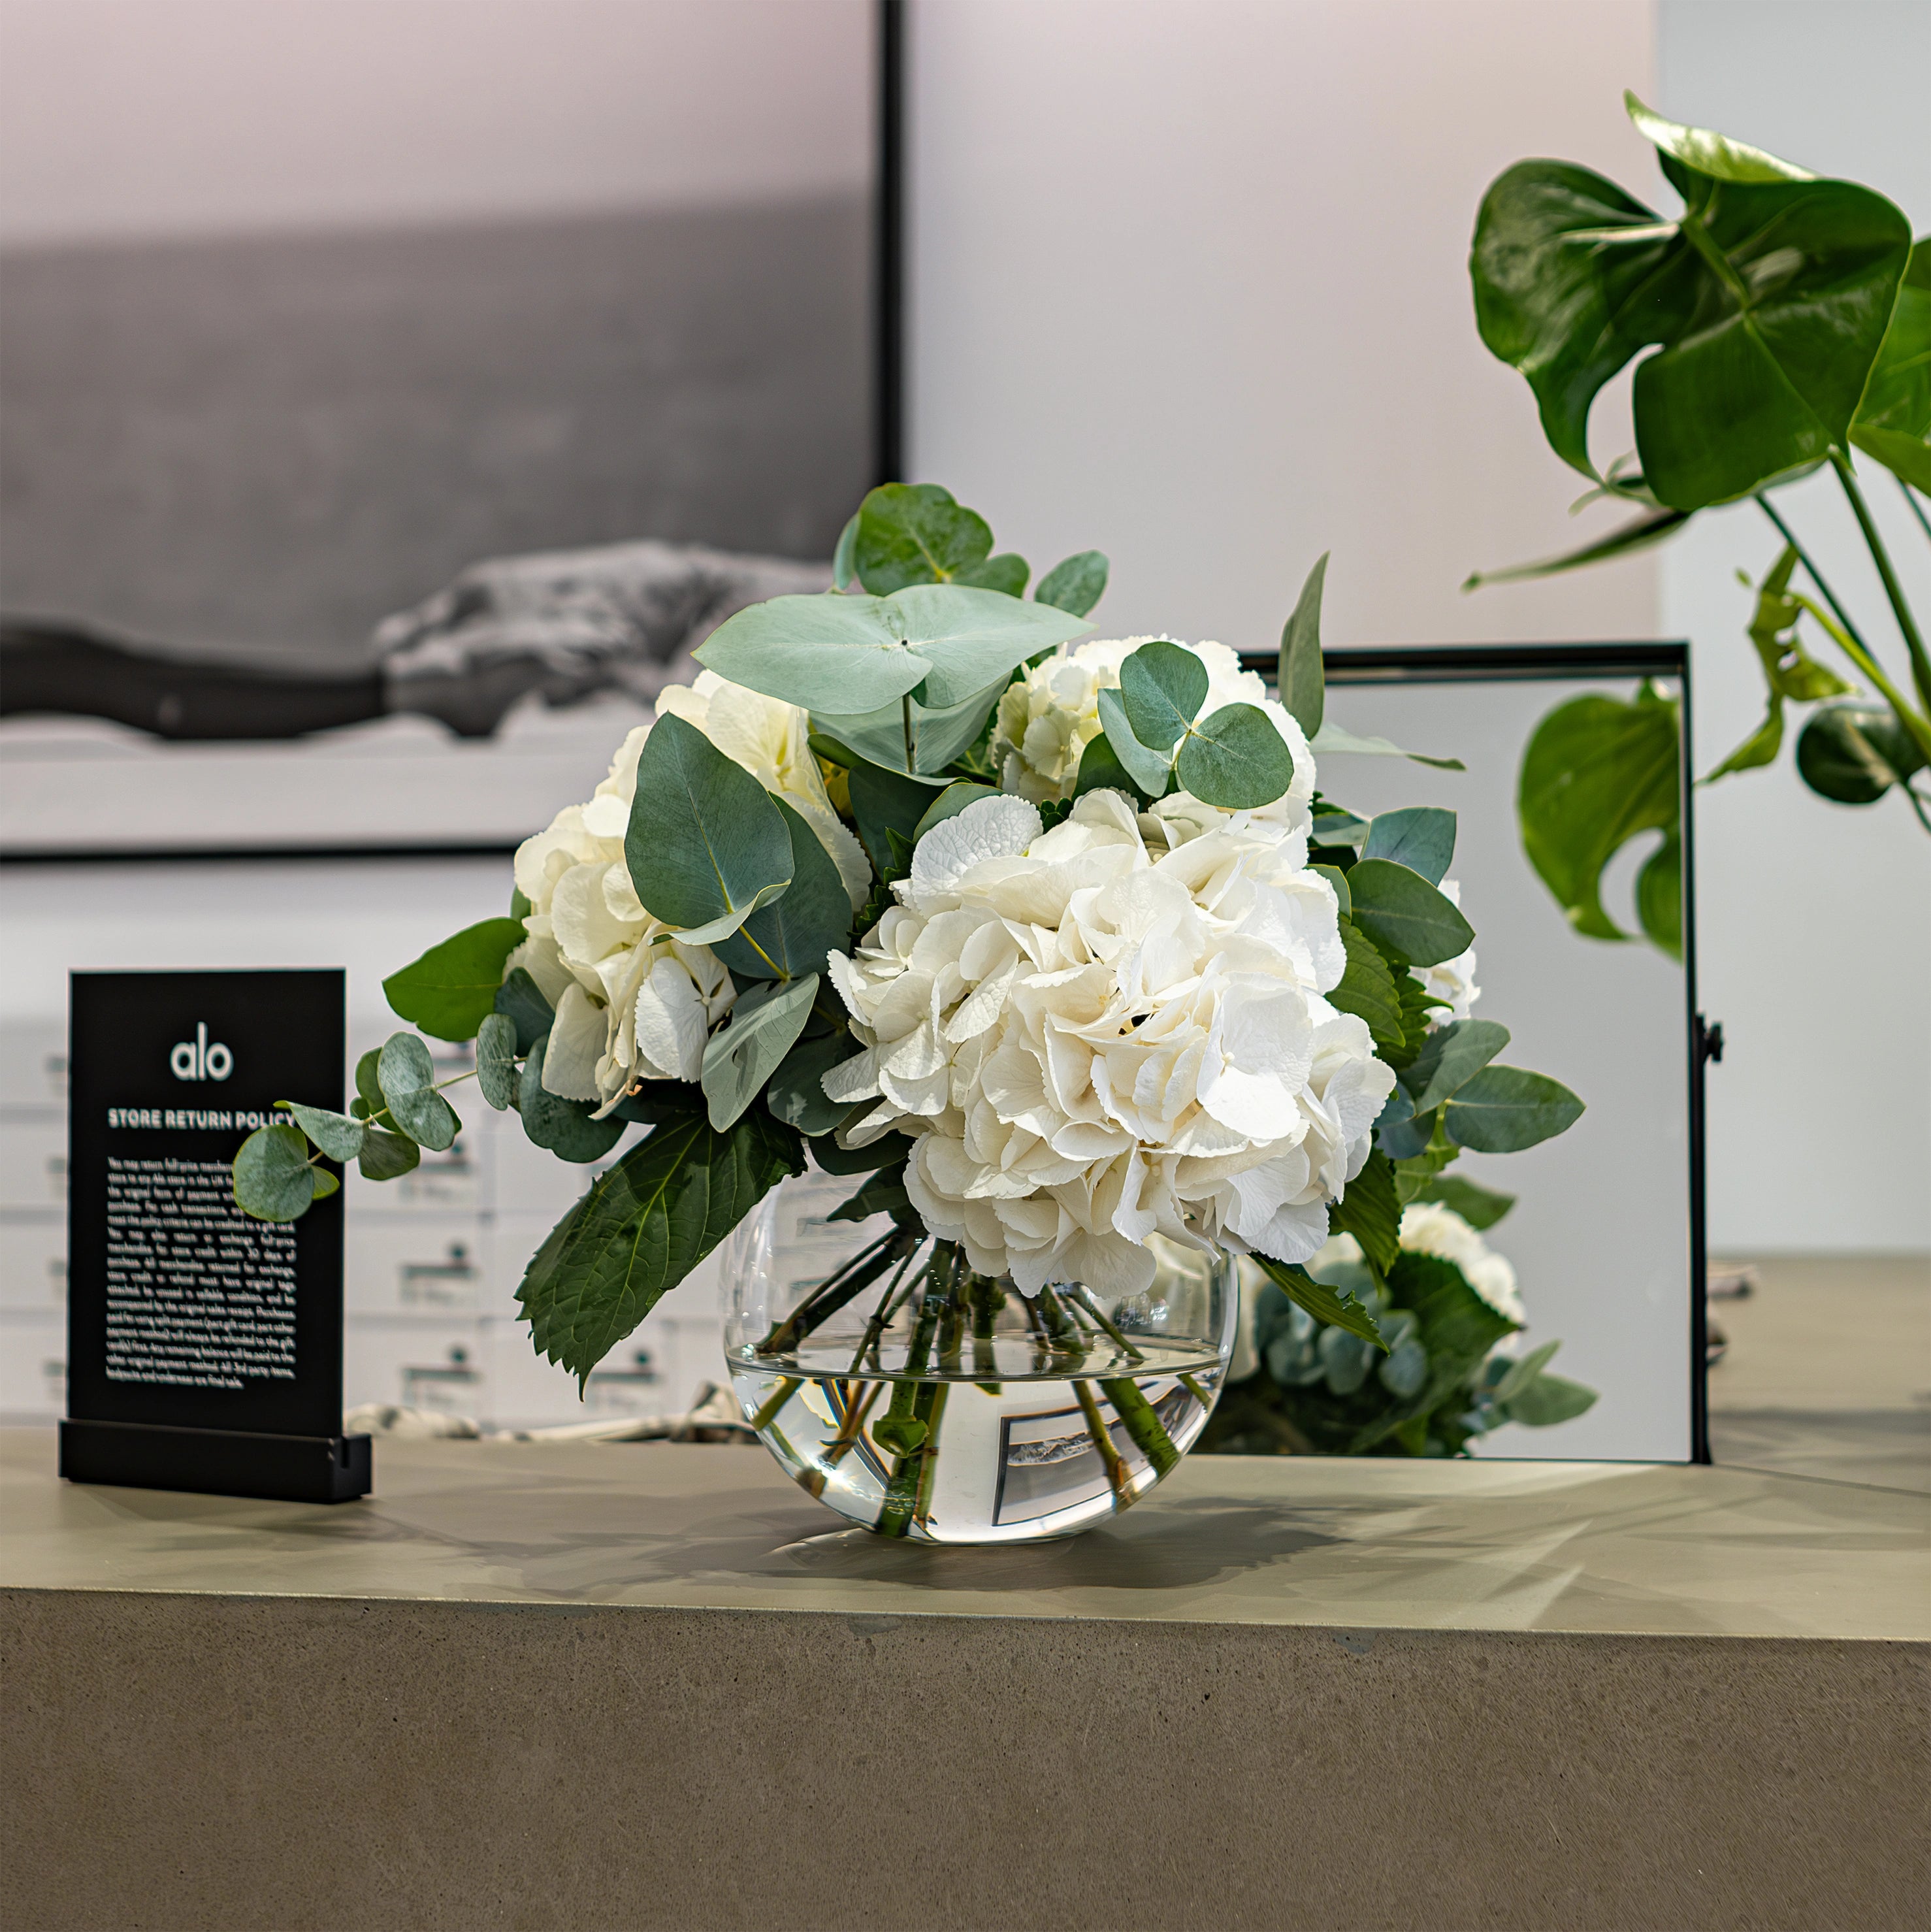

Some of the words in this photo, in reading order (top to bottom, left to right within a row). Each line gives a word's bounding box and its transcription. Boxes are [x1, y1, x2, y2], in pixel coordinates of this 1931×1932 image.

[171, 1021, 234, 1081] alo
[109, 1109, 162, 1128] STORE
[166, 1110, 232, 1130] RETURN
